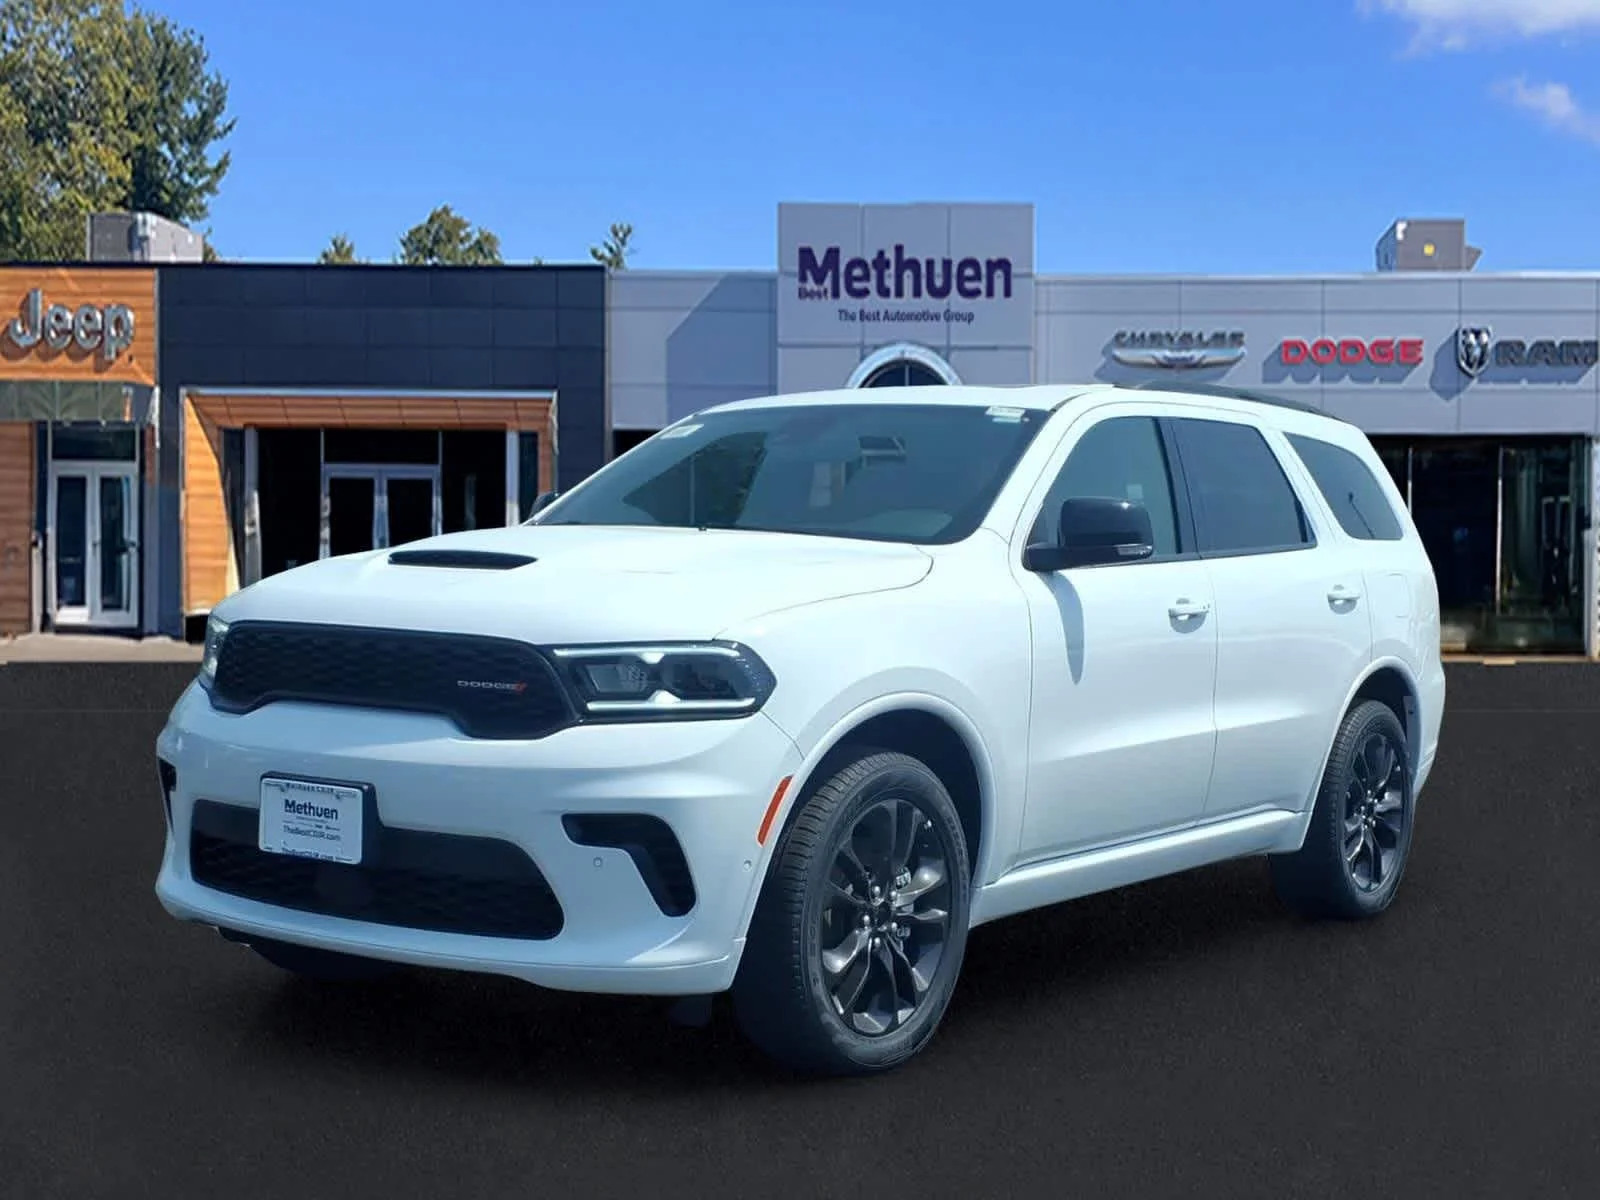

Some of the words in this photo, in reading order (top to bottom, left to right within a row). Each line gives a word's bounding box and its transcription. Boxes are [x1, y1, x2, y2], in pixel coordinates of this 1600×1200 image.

[798, 244, 1012, 300] Methuen
[9, 288, 136, 361] Jeep
[838, 309, 856, 321] The
[859, 309, 880, 321] Best
[883, 309, 941, 322] Automotive
[943, 309, 975, 325] Group
[1113, 331, 1245, 348] CHRYSLER
[1281, 338, 1424, 365] DODGE
[1494, 340, 1599, 366] RAM
[284, 799, 338, 820] Methuen
